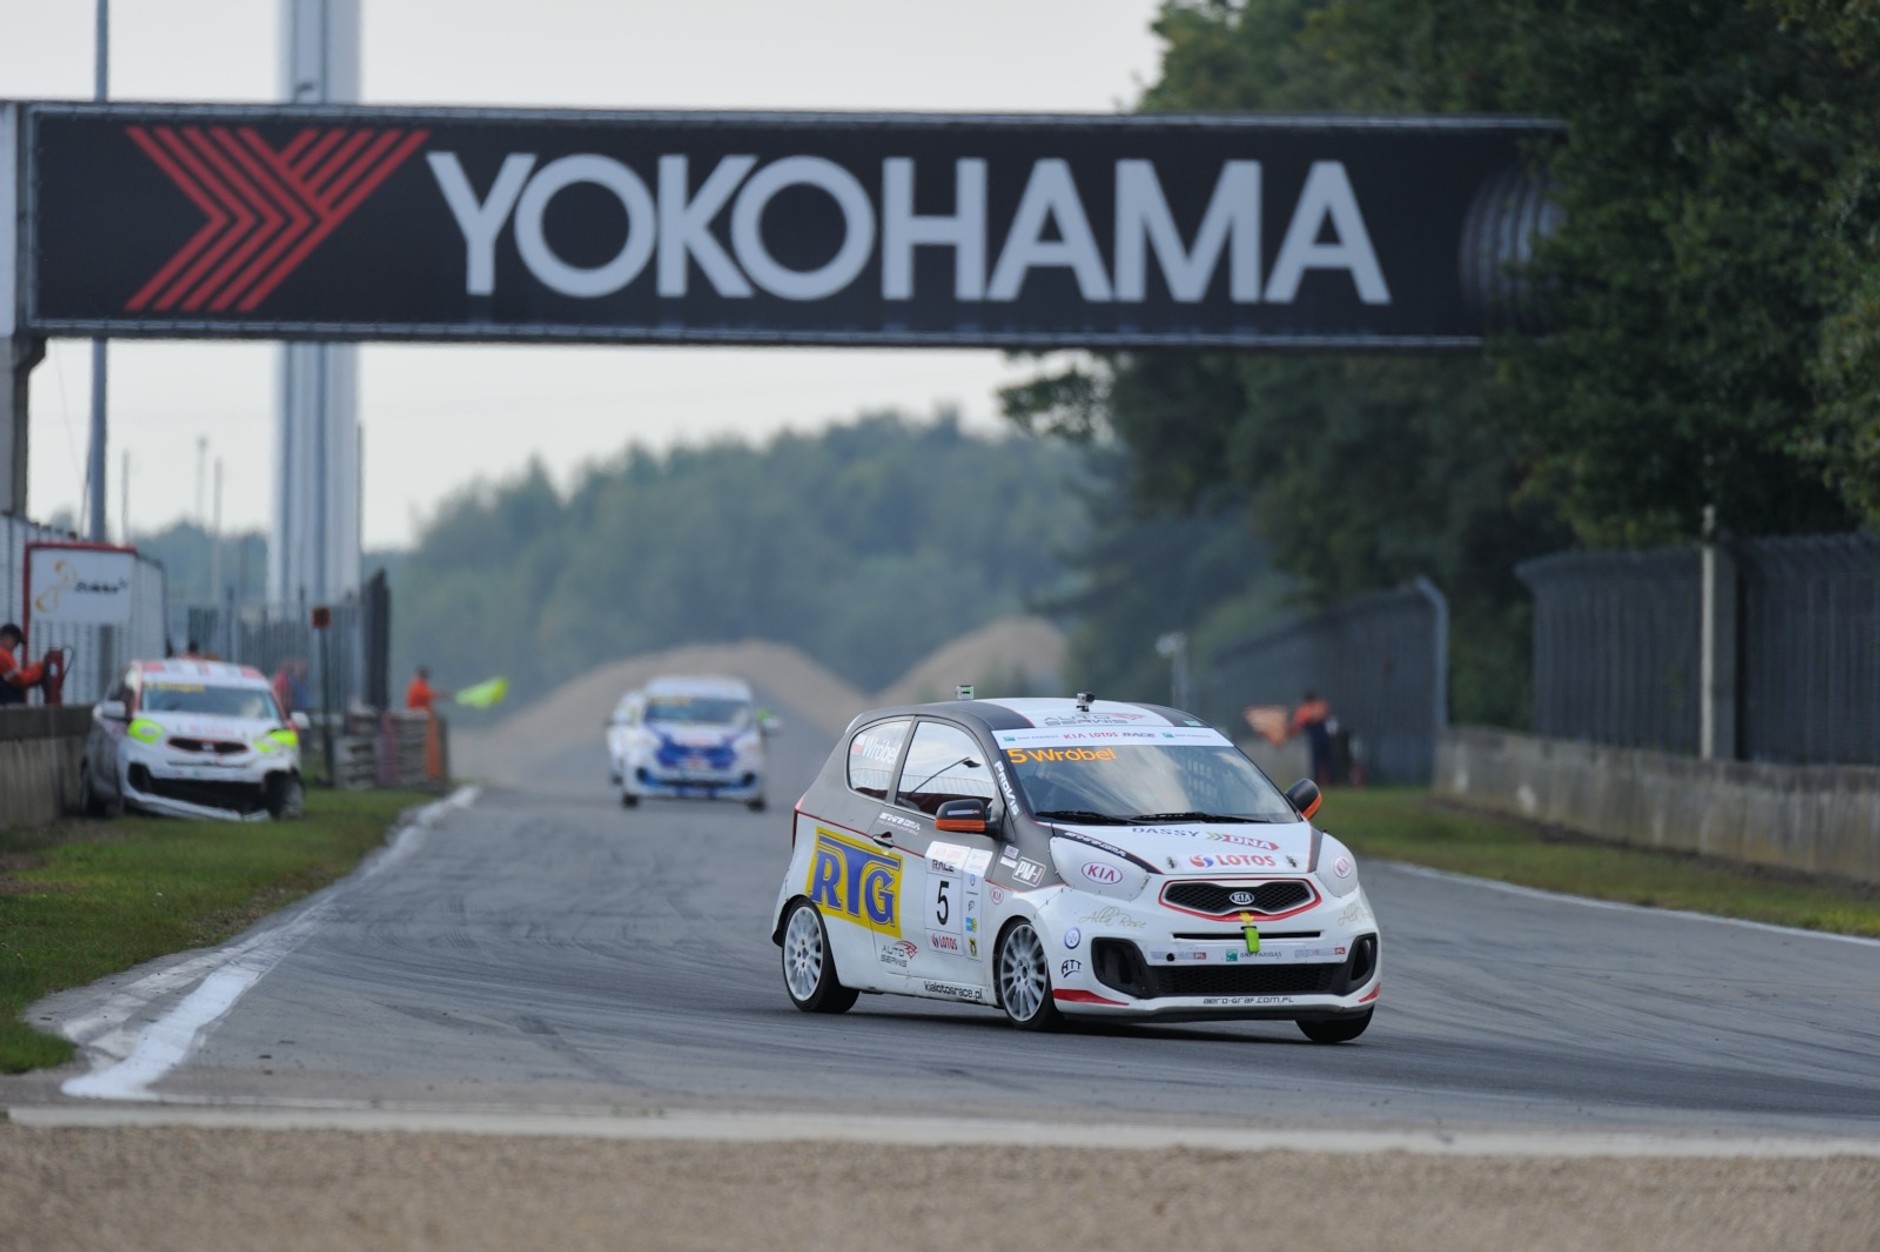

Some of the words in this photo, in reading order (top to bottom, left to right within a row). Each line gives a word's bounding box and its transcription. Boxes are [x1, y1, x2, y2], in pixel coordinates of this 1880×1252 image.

[427, 151, 1391, 306] YOKOHAMA
[1063, 732, 1087, 740] KIA
[1088, 731, 1119, 739] LOTOS
[1006, 748, 1028, 764] 5
[1229, 835, 1273, 851] DNA
[1215, 854, 1277, 867] LOTOS
[1336, 857, 1351, 876] KIA
[1087, 863, 1116, 882] KIA
[936, 880, 950, 926] 5
[1232, 892, 1250, 902] KIA
[939, 934, 958, 951] LOTOS
[881, 945, 905, 958] AUTO
